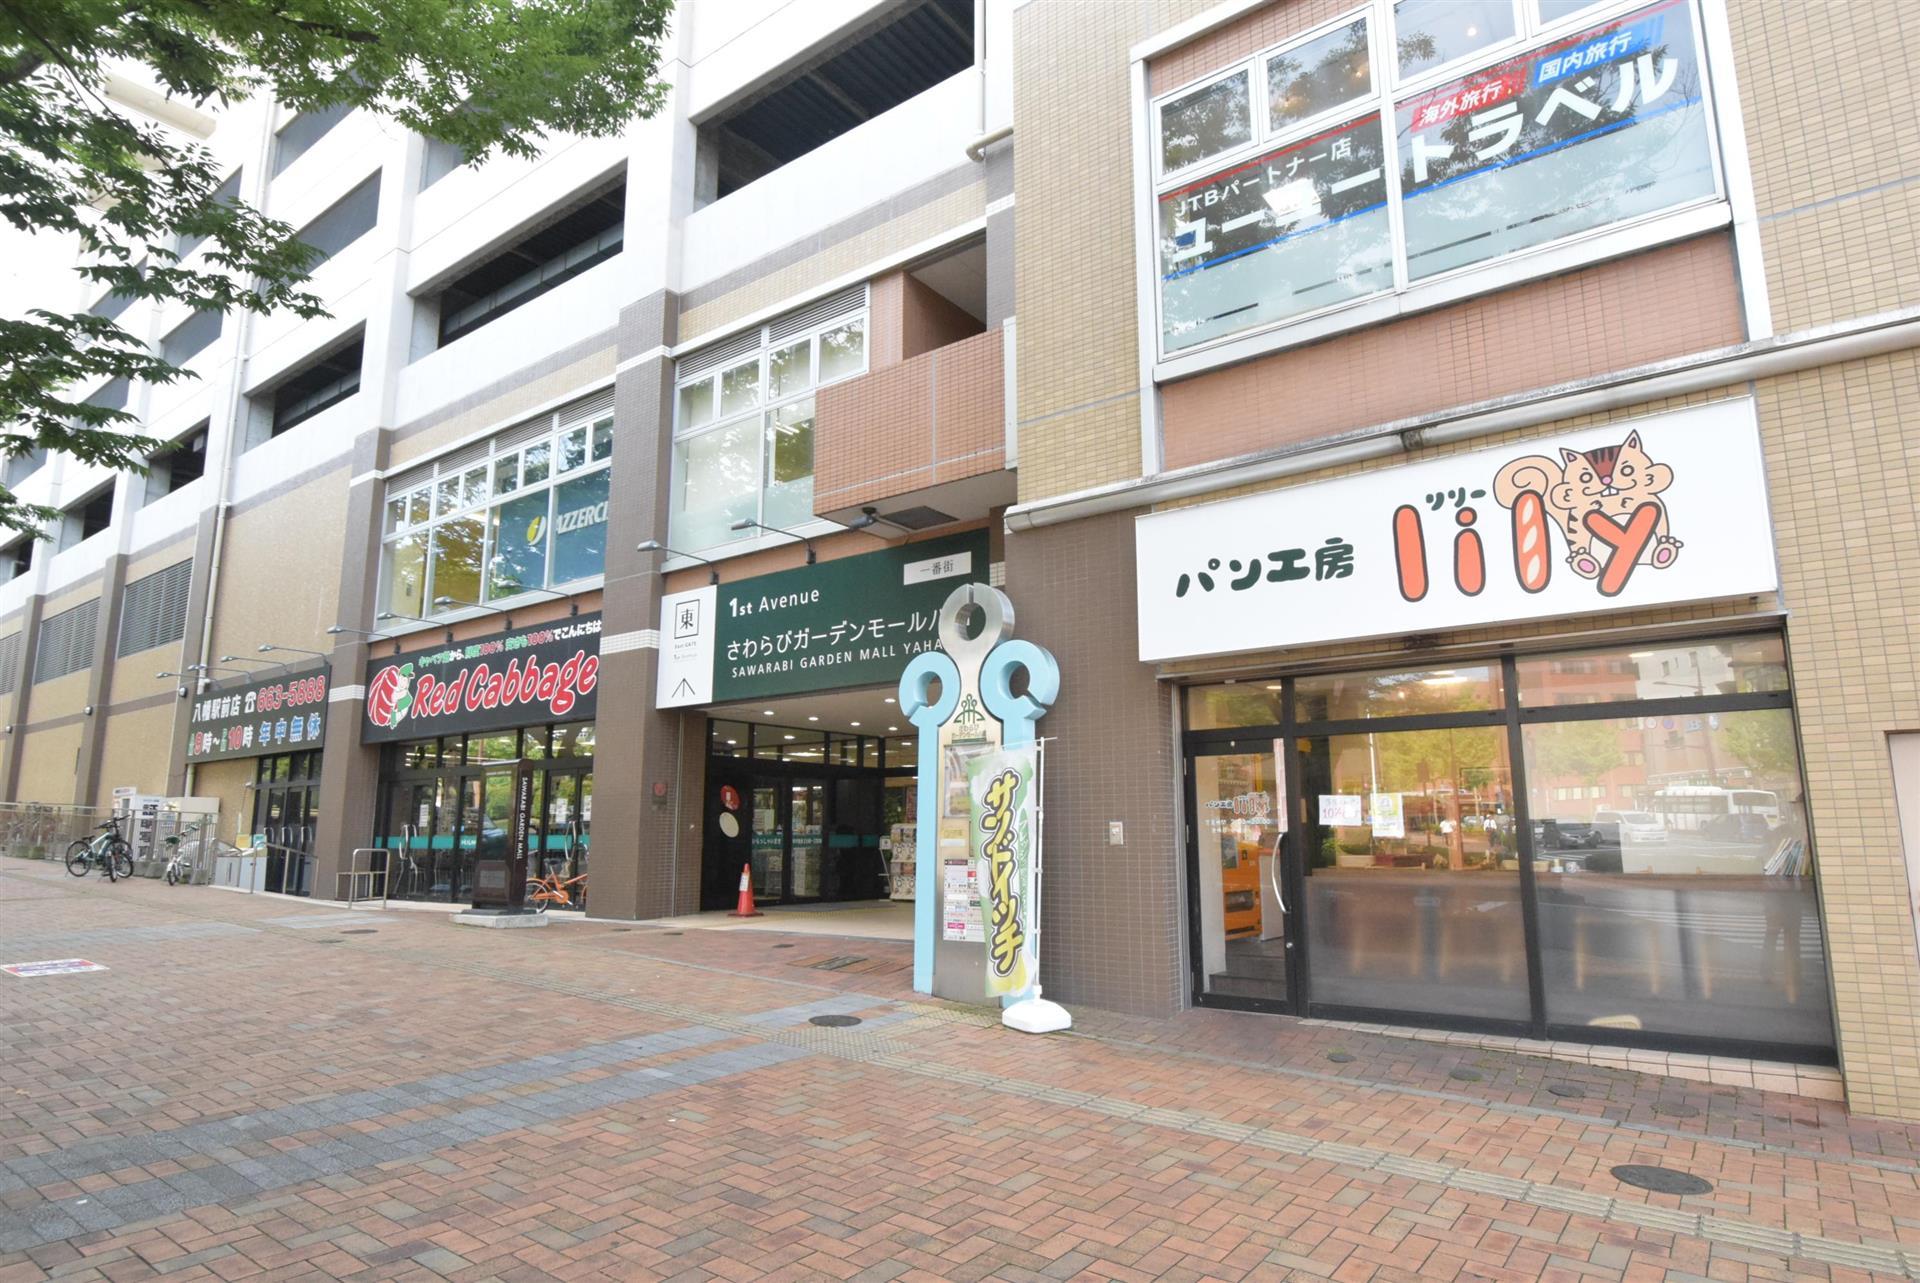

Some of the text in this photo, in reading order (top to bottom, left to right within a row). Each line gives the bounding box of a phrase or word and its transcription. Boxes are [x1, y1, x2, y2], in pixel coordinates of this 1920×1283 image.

[1538, 31, 1633, 83] 国内旅行
[1418, 79, 1504, 126] 海外旅行
[1176, 137, 1352, 216] JTBパートナー店
[1176, 537, 1354, 598] パン工房
[1392, 489, 1663, 602] lily
[680, 608, 695, 630] 東
[729, 589, 820, 617] 1st Avenue
[732, 638, 943, 678] SAWARABI GARDEN MALL YAHA
[411, 650, 599, 719] Red Cabbage
[258, 712, 321, 746] 年中無休
[518, 812, 526, 841] GARDEN
[516, 842, 524, 860] MALL
[981, 769, 1024, 975] サンドイッチ
